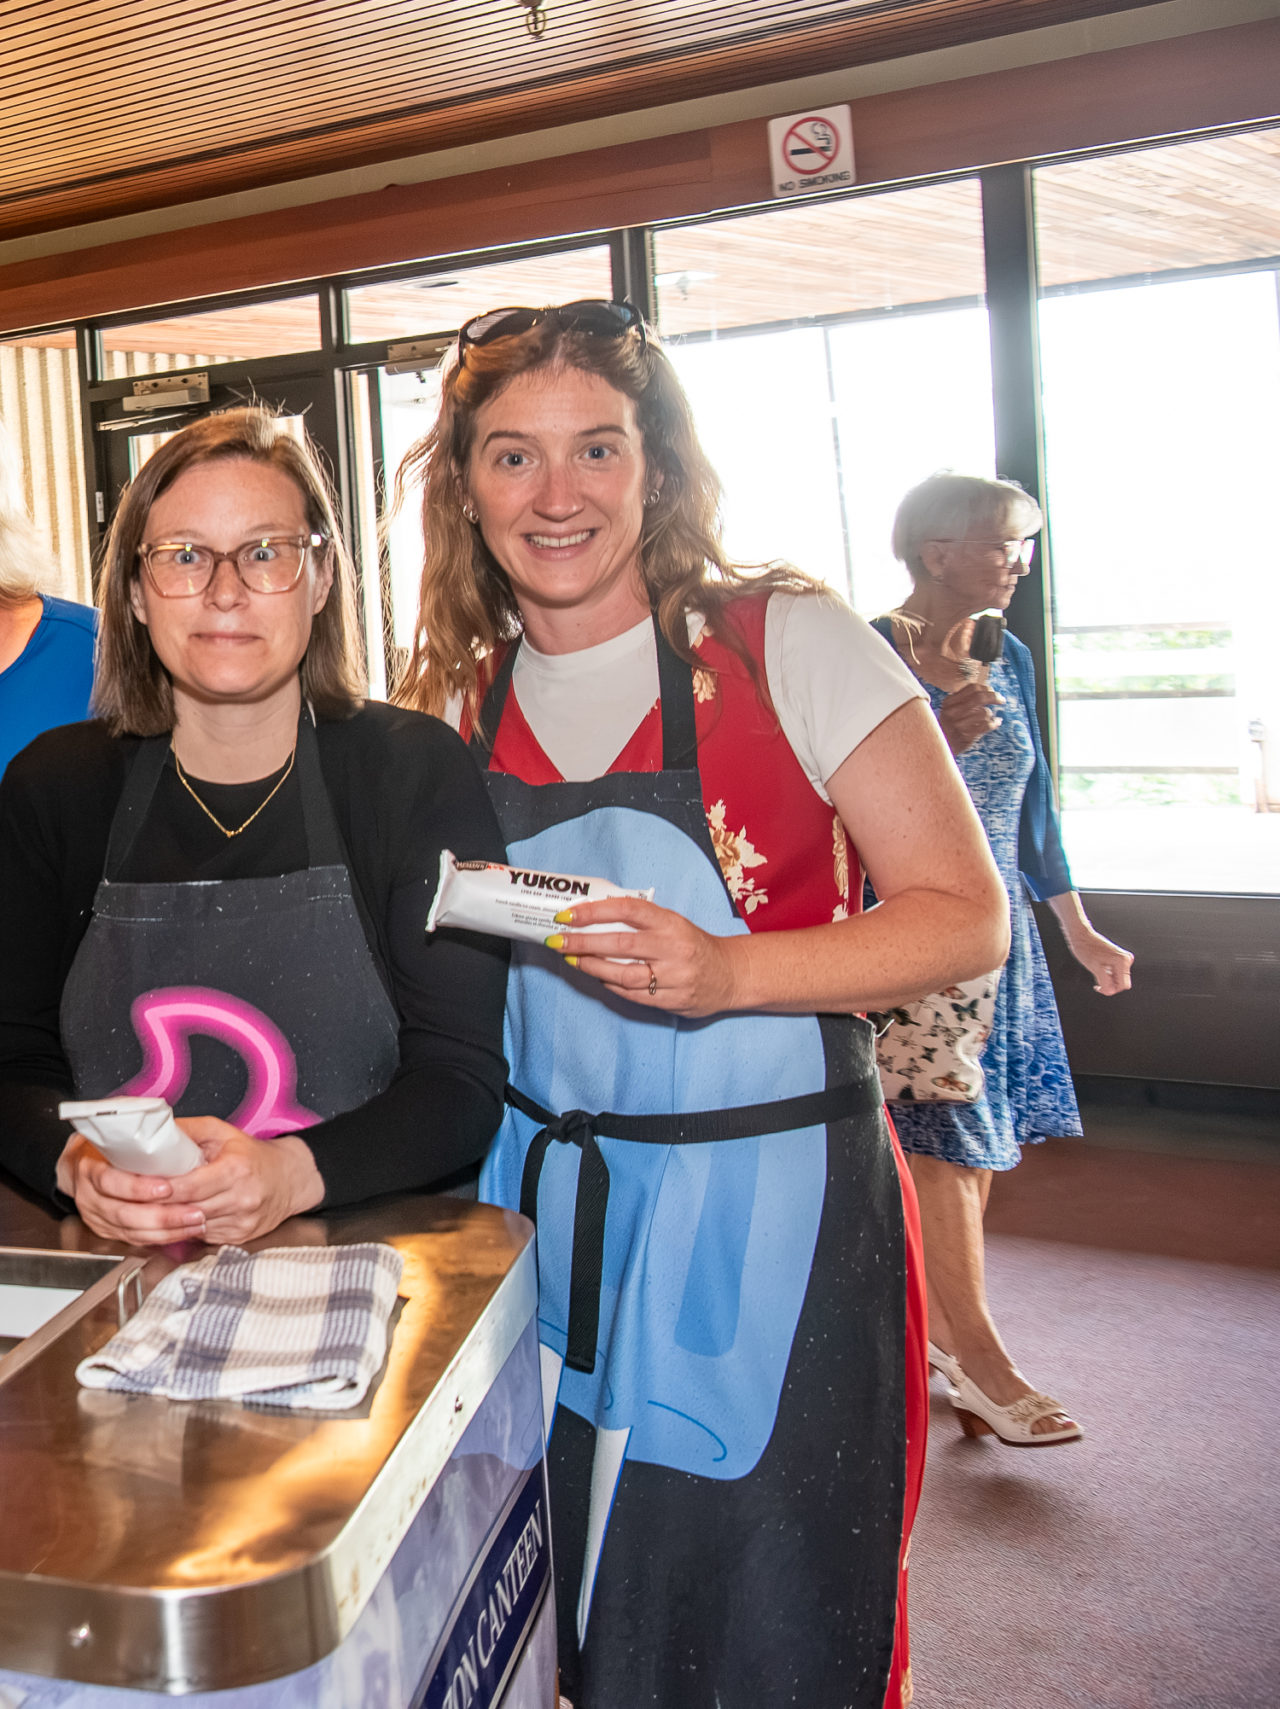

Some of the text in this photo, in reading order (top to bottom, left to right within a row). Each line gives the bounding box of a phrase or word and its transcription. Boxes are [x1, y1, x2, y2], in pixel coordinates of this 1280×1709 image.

[779, 170, 851, 192] NO SMOKING
[509, 870, 590, 896] YUKON
[442, 1499, 543, 1709] ON CANTEEN
